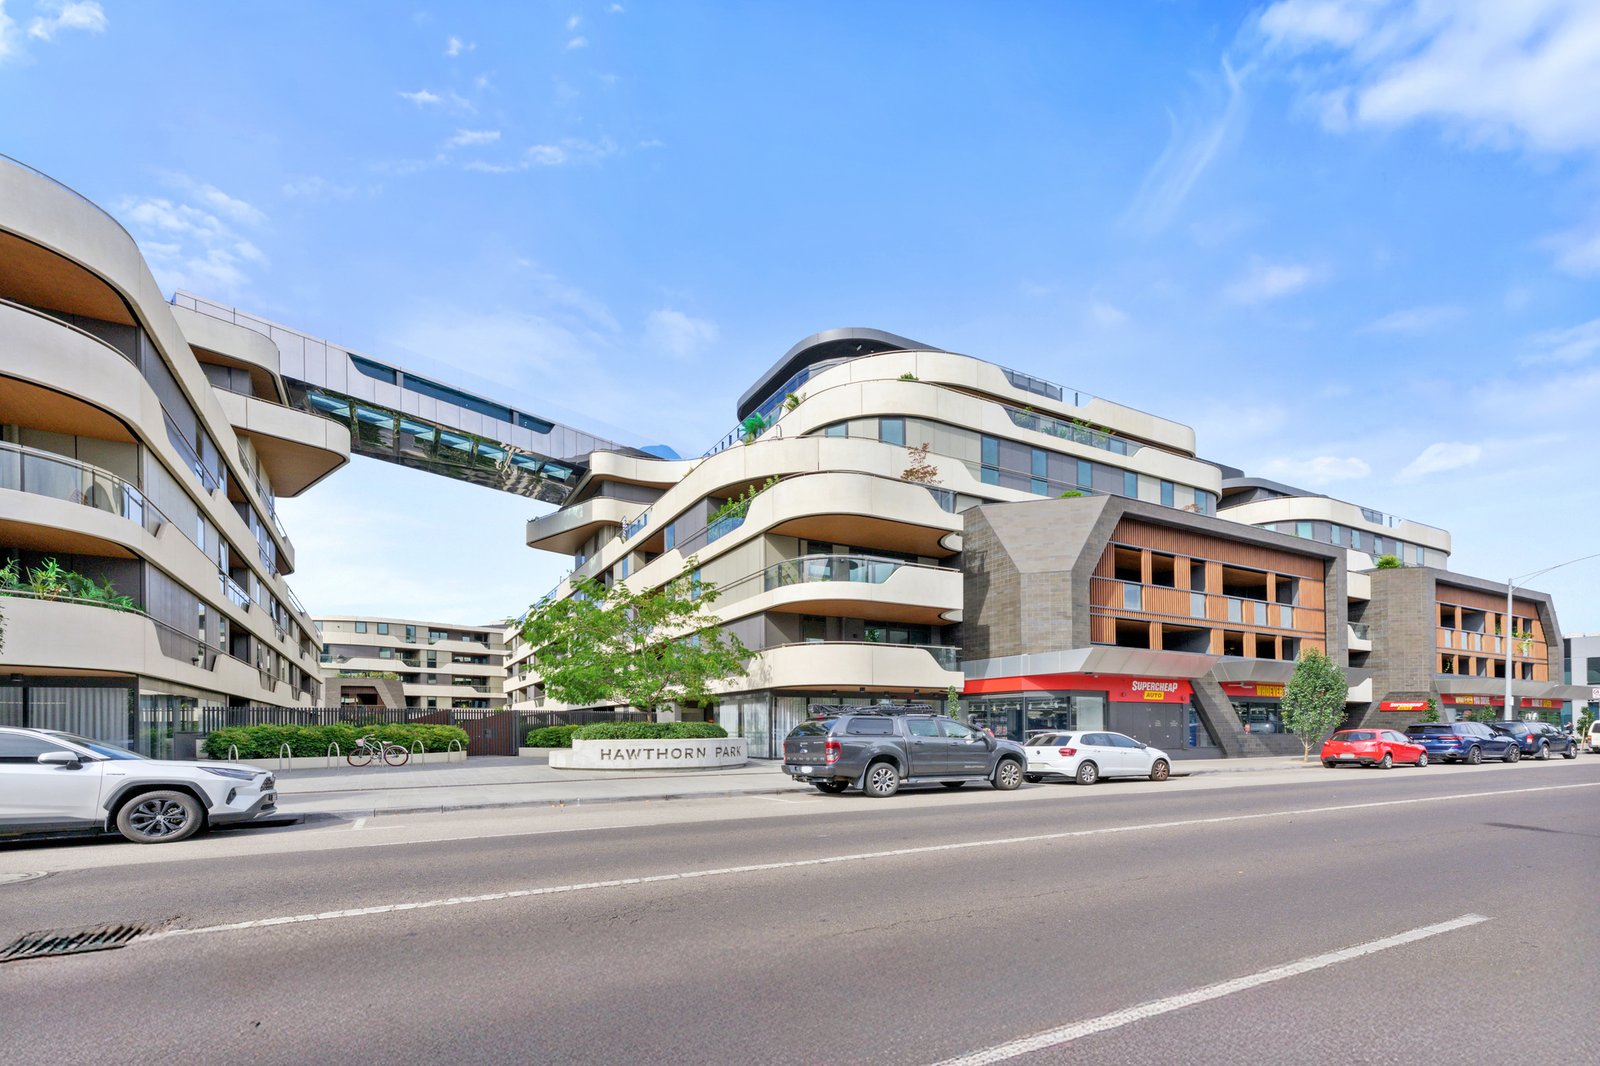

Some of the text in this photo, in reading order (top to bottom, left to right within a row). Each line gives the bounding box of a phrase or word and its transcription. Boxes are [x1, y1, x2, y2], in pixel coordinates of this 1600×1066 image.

[1131, 681, 1178, 692] SUPERCHEAP
[600, 746, 742, 760] HAWTHORN PARK
